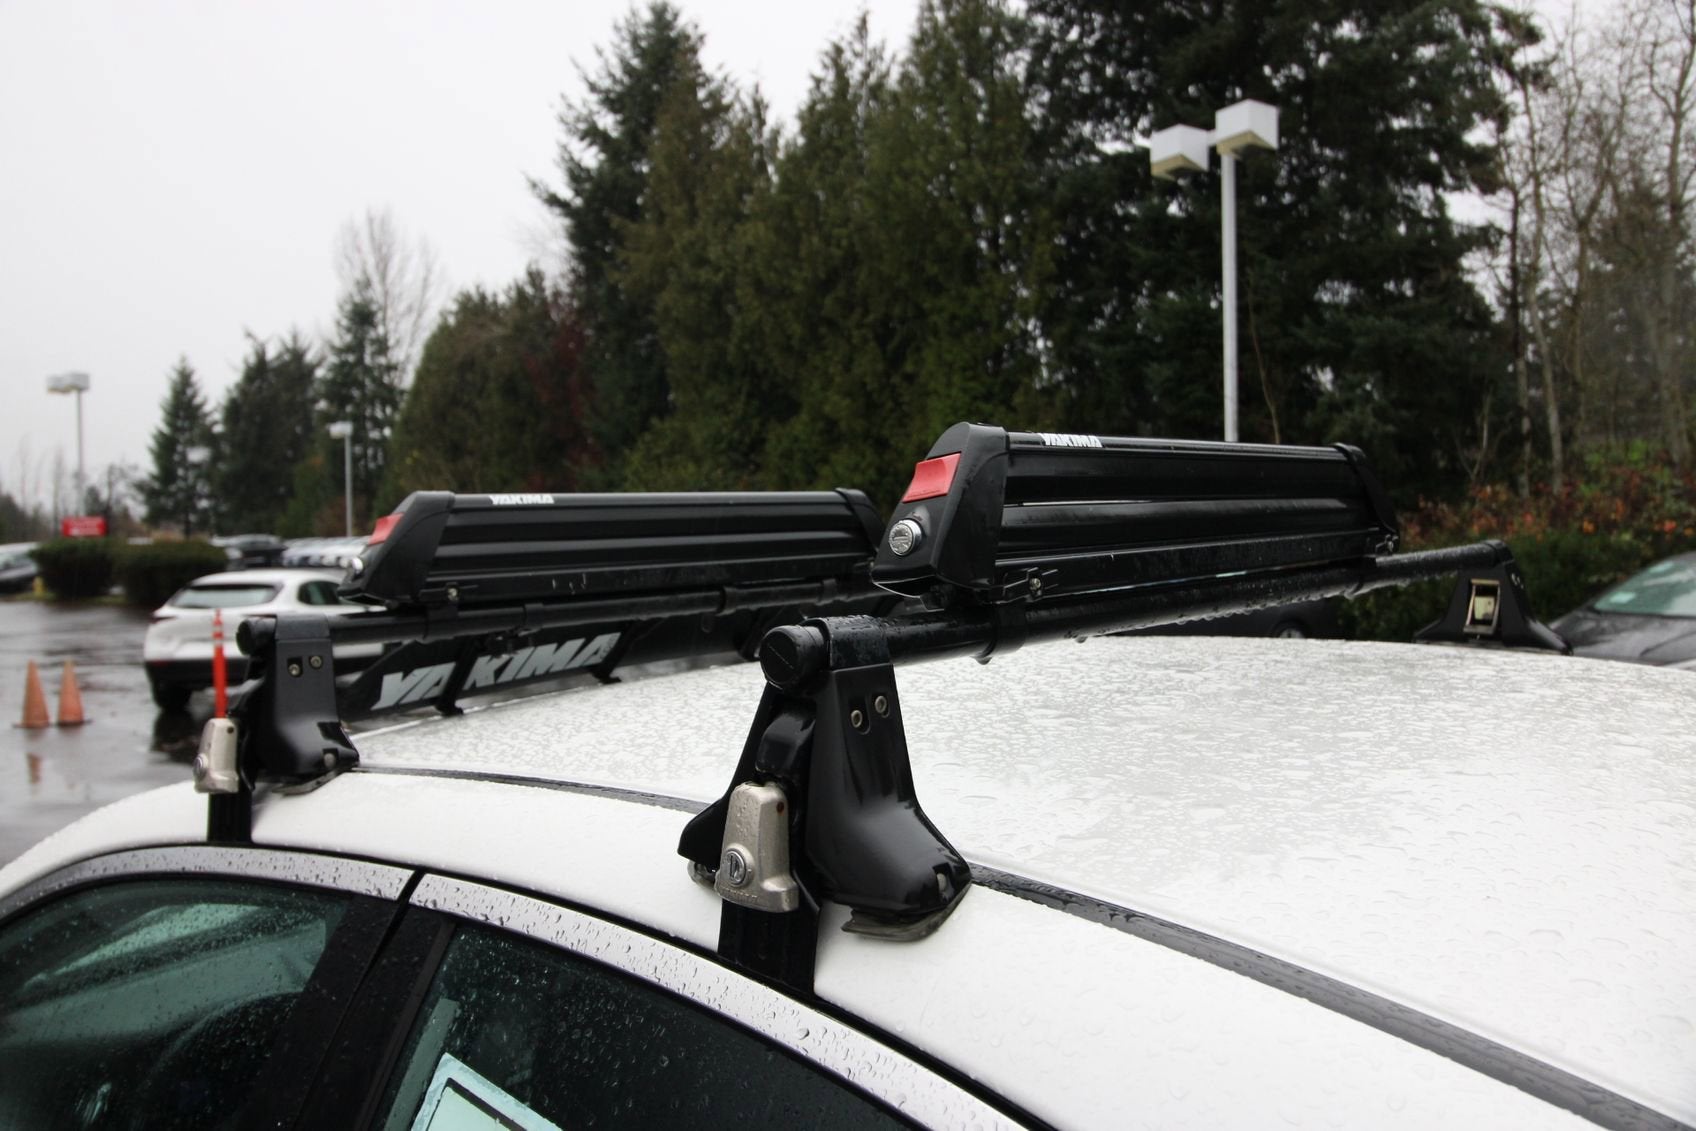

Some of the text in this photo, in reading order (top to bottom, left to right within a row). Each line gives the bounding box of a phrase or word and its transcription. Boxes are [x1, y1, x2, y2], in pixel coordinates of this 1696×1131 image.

[1038, 432, 1102, 448] YAKIMA
[489, 493, 555, 505] YAKIMA
[370, 631, 622, 711] YAKIMA
